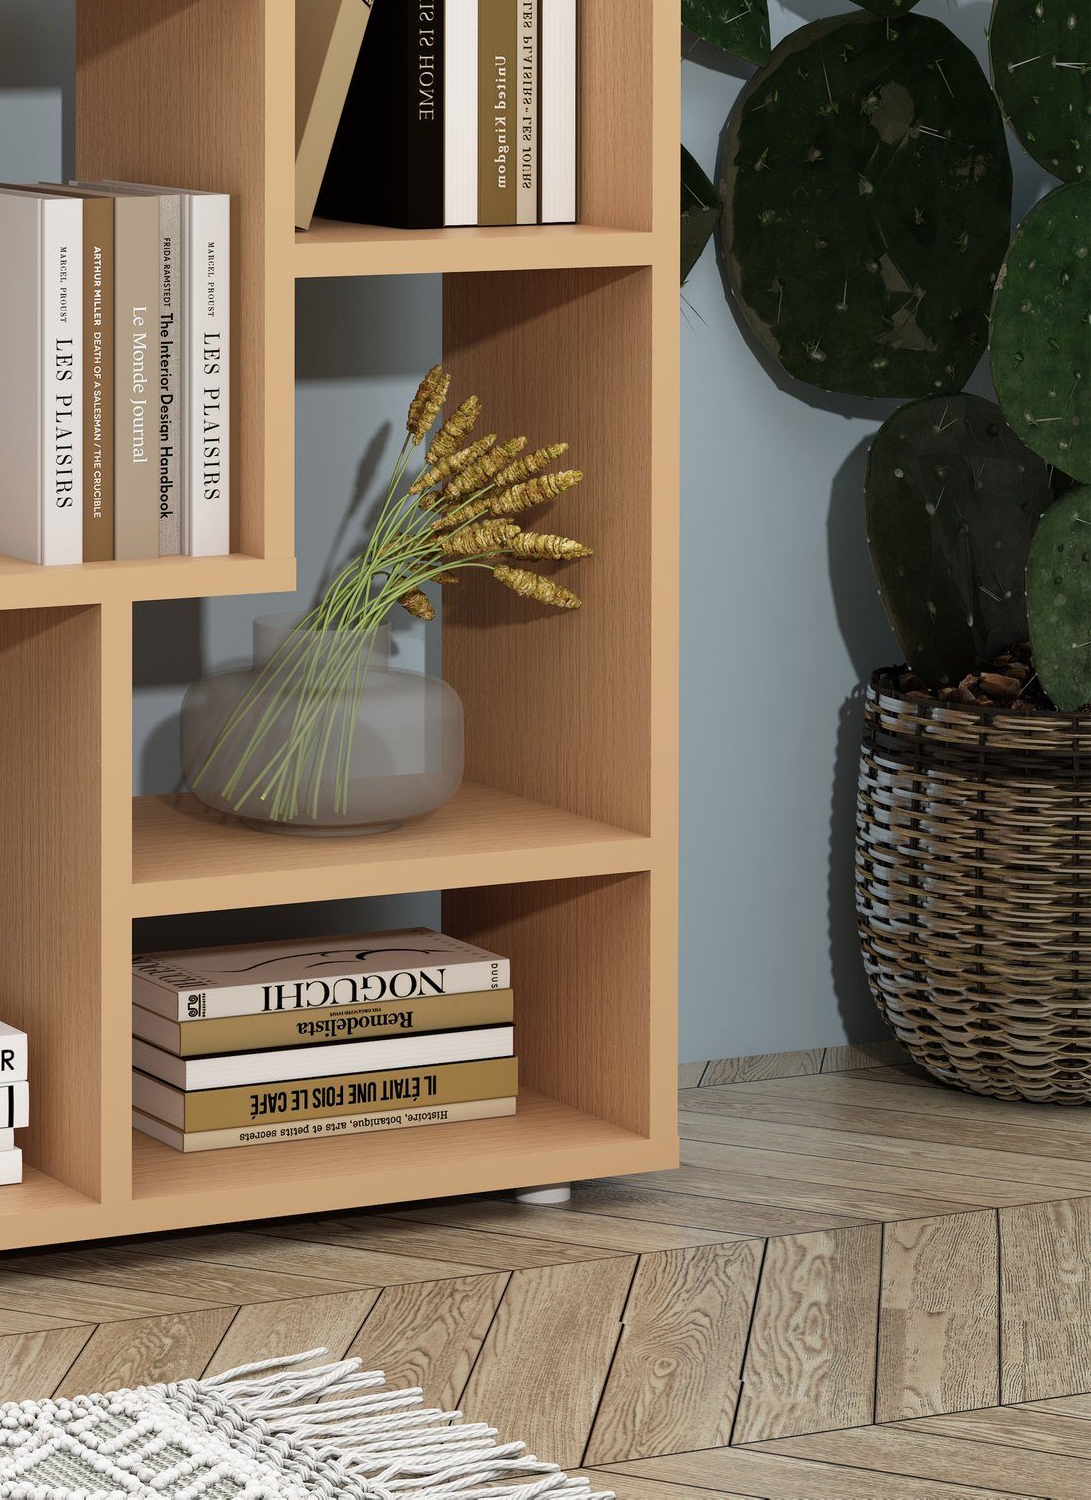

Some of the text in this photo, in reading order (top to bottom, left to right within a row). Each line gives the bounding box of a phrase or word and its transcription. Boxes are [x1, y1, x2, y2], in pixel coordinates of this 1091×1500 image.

[93, 246, 102, 287] ARTHUR
[93, 289, 102, 326] MILLER
[93, 331, 102, 364] DEATH
[55, 246, 73, 508] MARCEL PROUST LES PLAISIRS
[93, 365, 102, 380] OF
[93, 381, 102, 389] A
[129, 306, 148, 463] Le Monde Journal
[158, 237, 174, 519] FRIDA RAMSTEDT The Interior Design Handbook
[203, 241, 221, 500] MARCEL PROUST LES PLAISIRS
[93, 390, 102, 441] SALESMAN
[93, 449, 102, 469] THE
[93, 470, 102, 518] CRUCIBLE
[261, 968, 446, 1012] NOGUCHI
[490, 962, 499, 989] DUUS
[297, 1011, 414, 1038] Remodelista
[250, 1074, 437, 1121] IL ÉTAIT UNE FOIS LE CAFÉ
[238, 1108, 450, 1143] Histoire, botanique, arts et petits secrets
